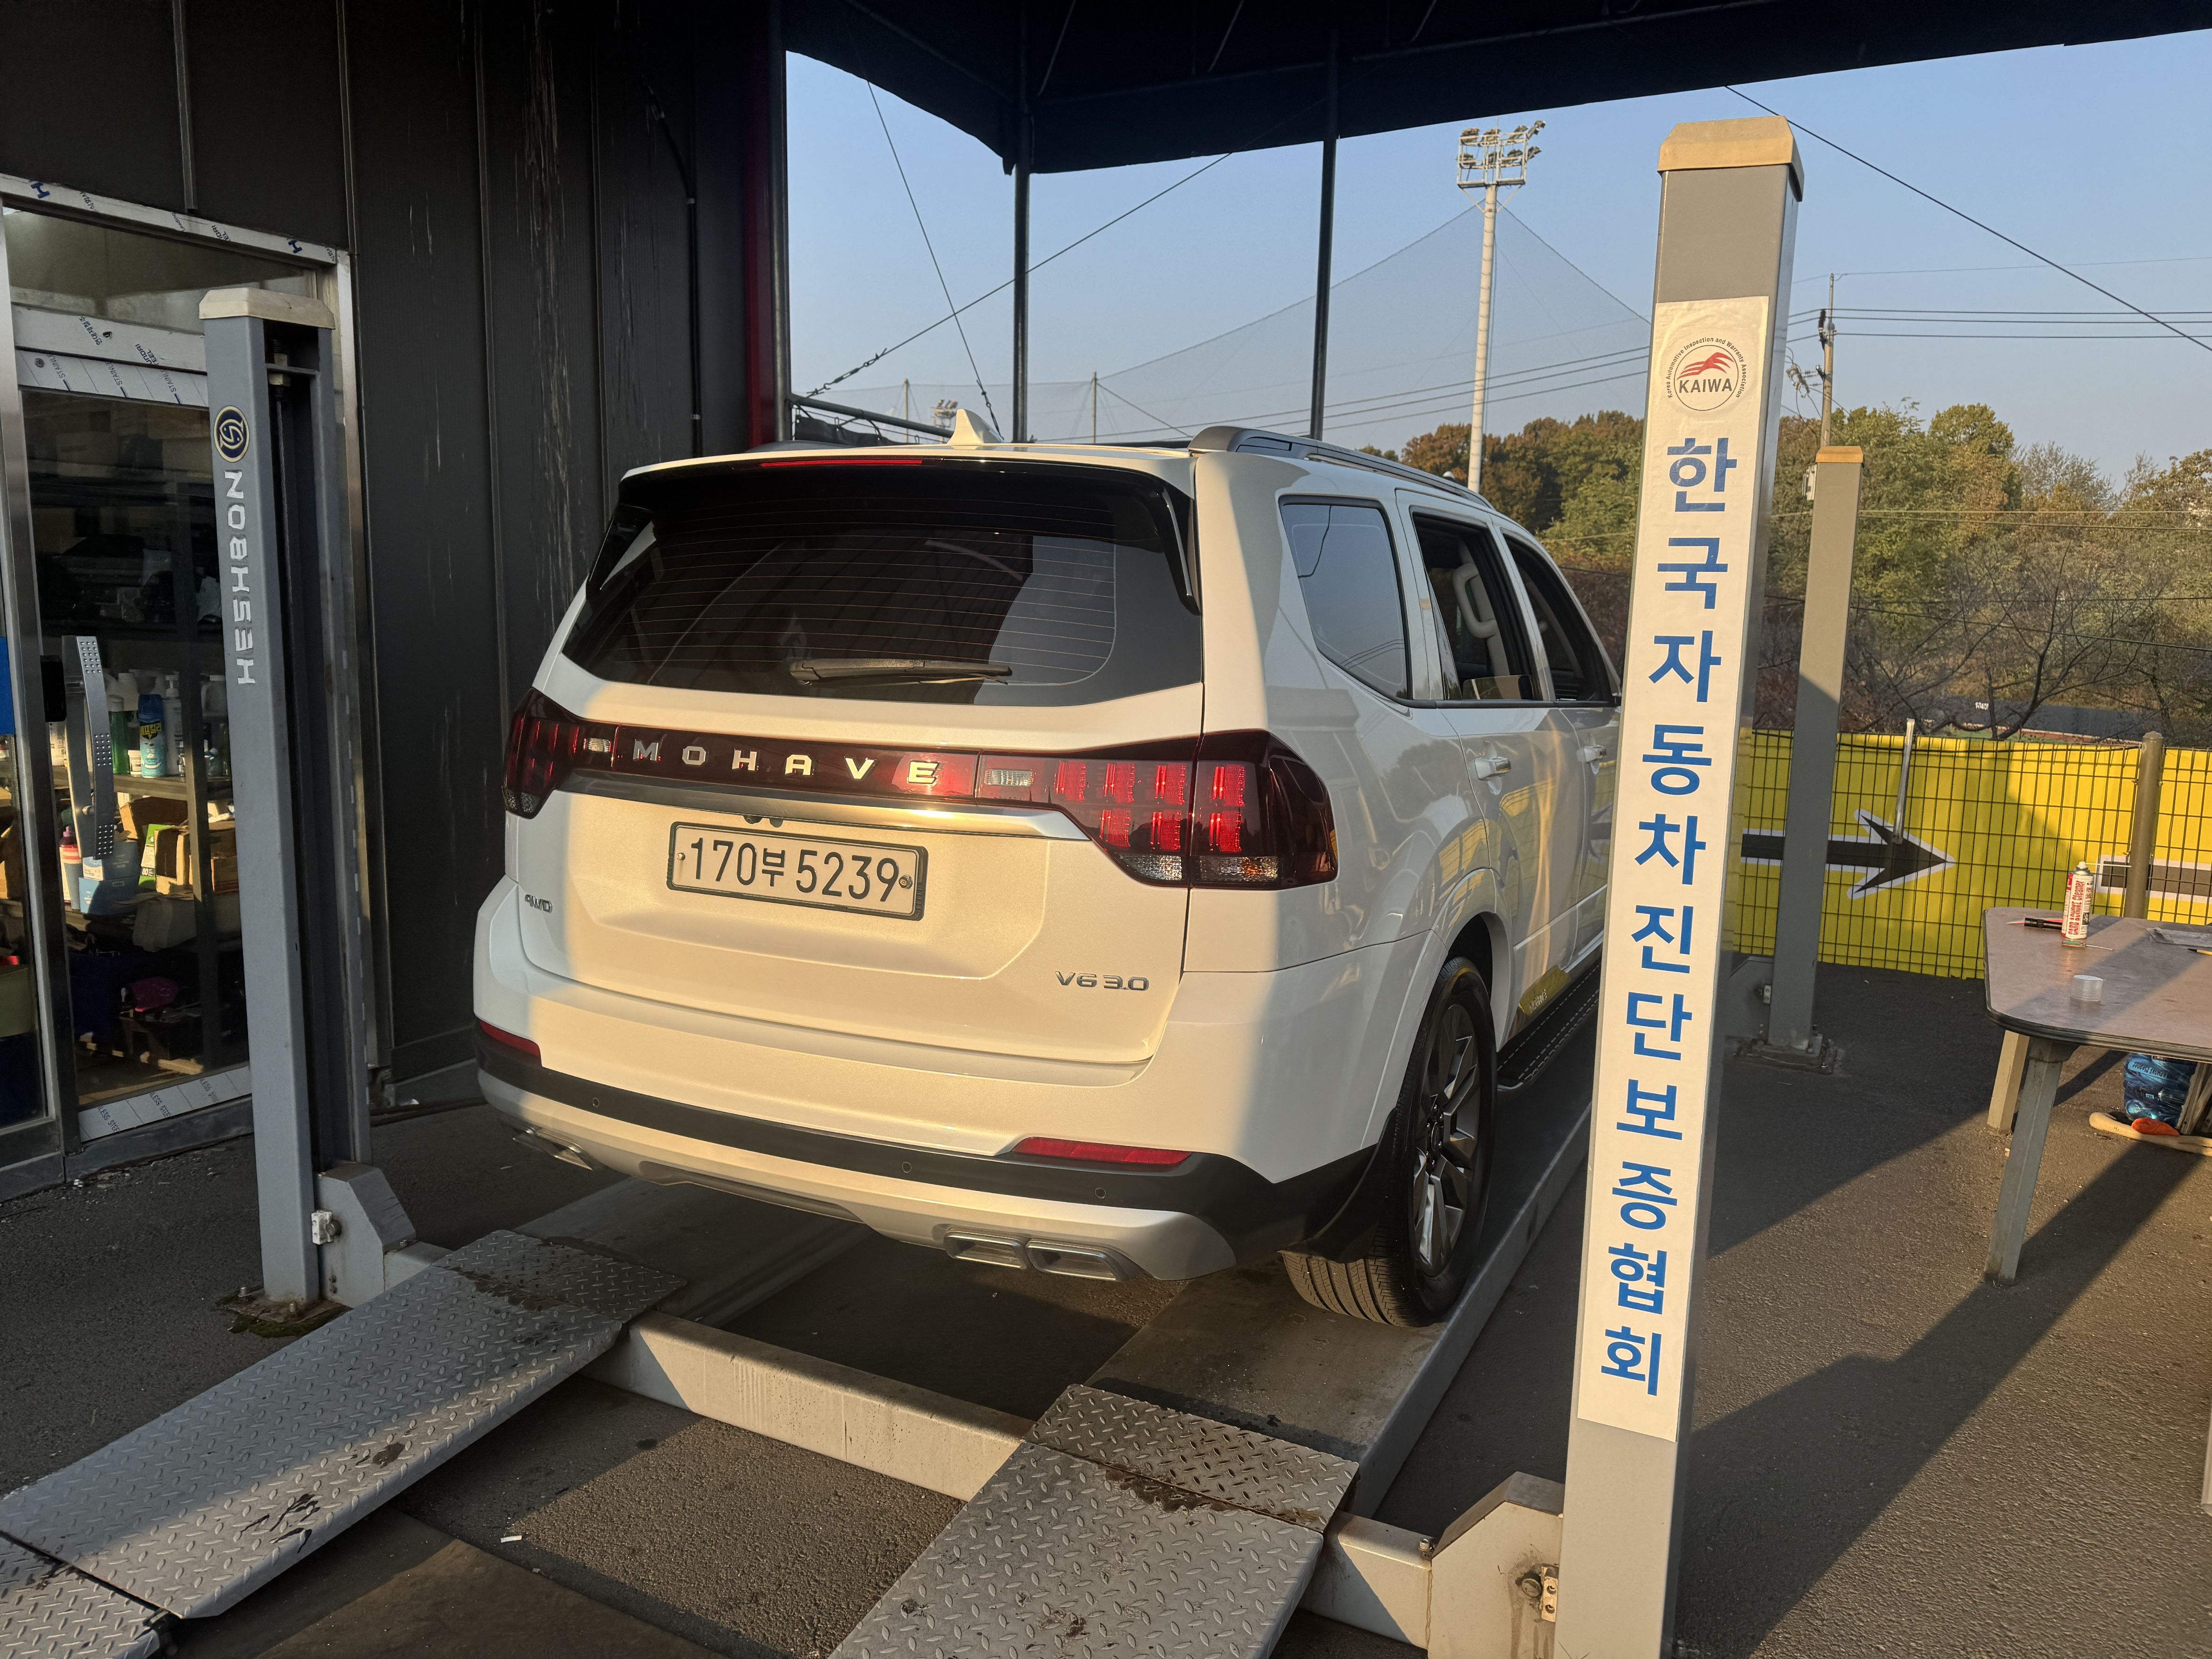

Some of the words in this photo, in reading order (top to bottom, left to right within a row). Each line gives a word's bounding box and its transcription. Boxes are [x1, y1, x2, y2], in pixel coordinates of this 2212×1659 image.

[1666, 349, 1684, 379] Automotive
[1684, 337, 1714, 350] Inspection
[1726, 341, 1744, 362] Warranty
[1736, 364, 1747, 398] Association
[1679, 378, 1732, 393] KAIWA
[224, 470, 256, 685] HESHBON
[632, 739, 940, 785] MOHAVE
[690, 836, 786, 888] 170부
[795, 849, 899, 903] 5239
[2072, 881, 2085, 900] Cleaner
[525, 894, 553, 913] 4WD
[1601, 437, 1737, 1396] 한국자동차진단보증협회
[1054, 971, 1098, 988] V6
[1103, 975, 1150, 992] 3.0
